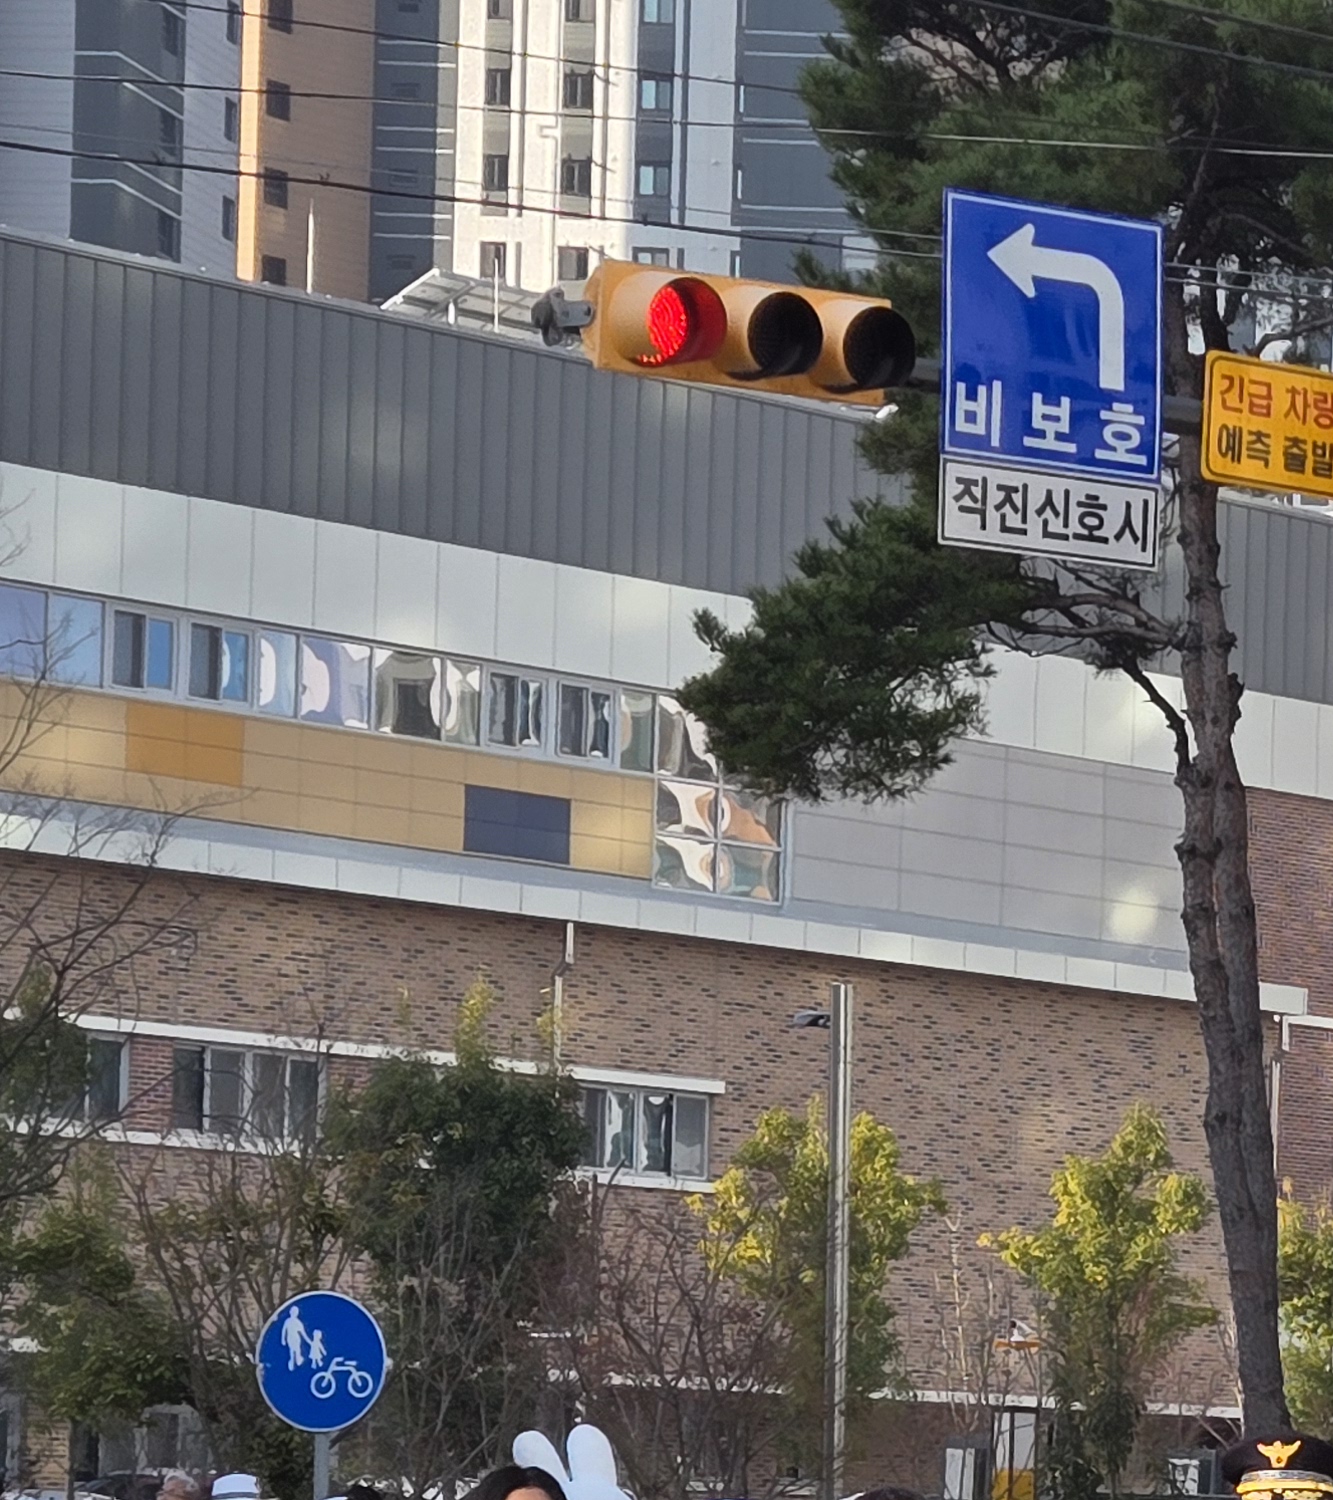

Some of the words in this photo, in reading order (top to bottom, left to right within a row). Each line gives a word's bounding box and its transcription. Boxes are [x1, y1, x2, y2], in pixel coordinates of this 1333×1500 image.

[1218, 373, 1273, 419] 긴급
[1217, 428, 1272, 467] 예측
[953, 475, 1150, 552] 직진신호시
